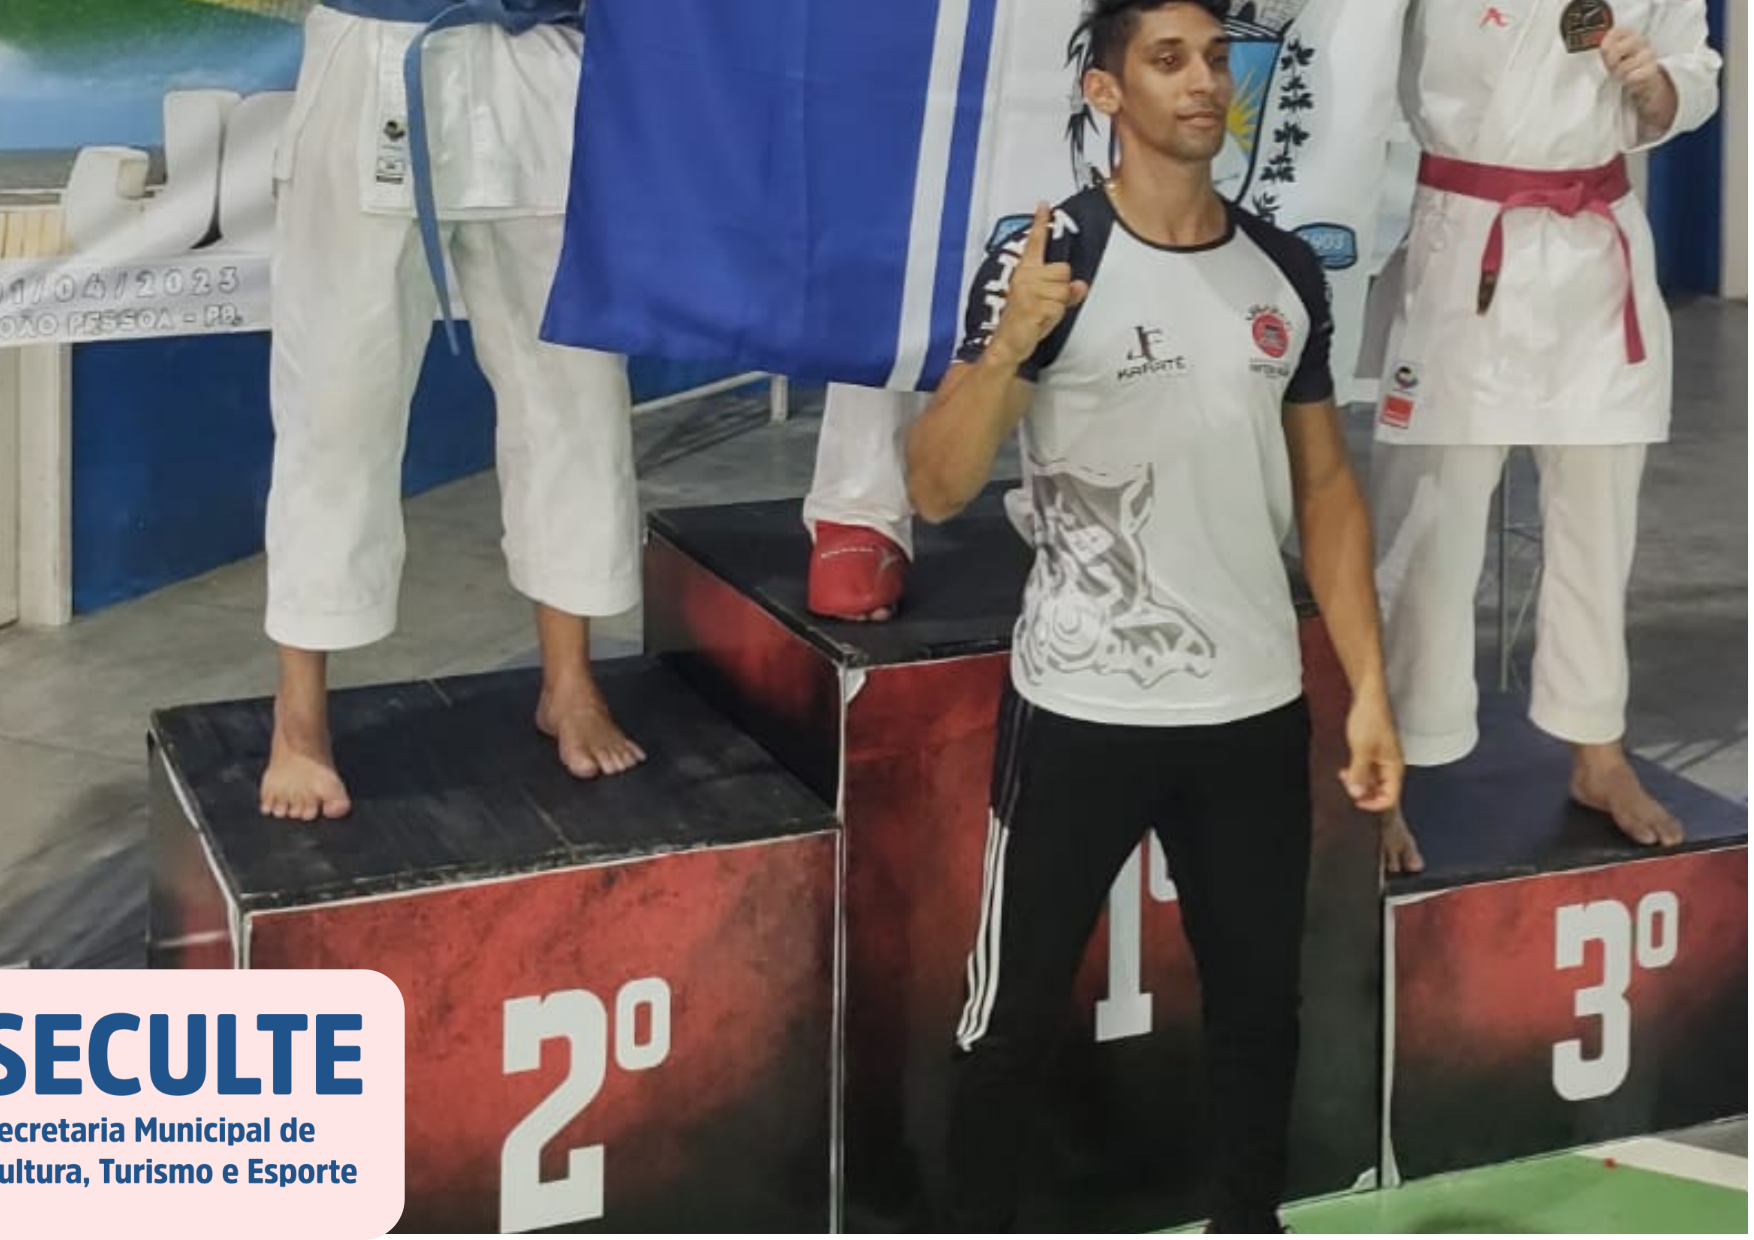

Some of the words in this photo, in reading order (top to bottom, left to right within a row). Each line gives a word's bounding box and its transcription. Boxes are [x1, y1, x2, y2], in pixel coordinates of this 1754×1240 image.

[67, 306, 178, 337] PESSOA
[1552, 890, 1679, 1102] 3º
[500, 974, 672, 1235] 2º
